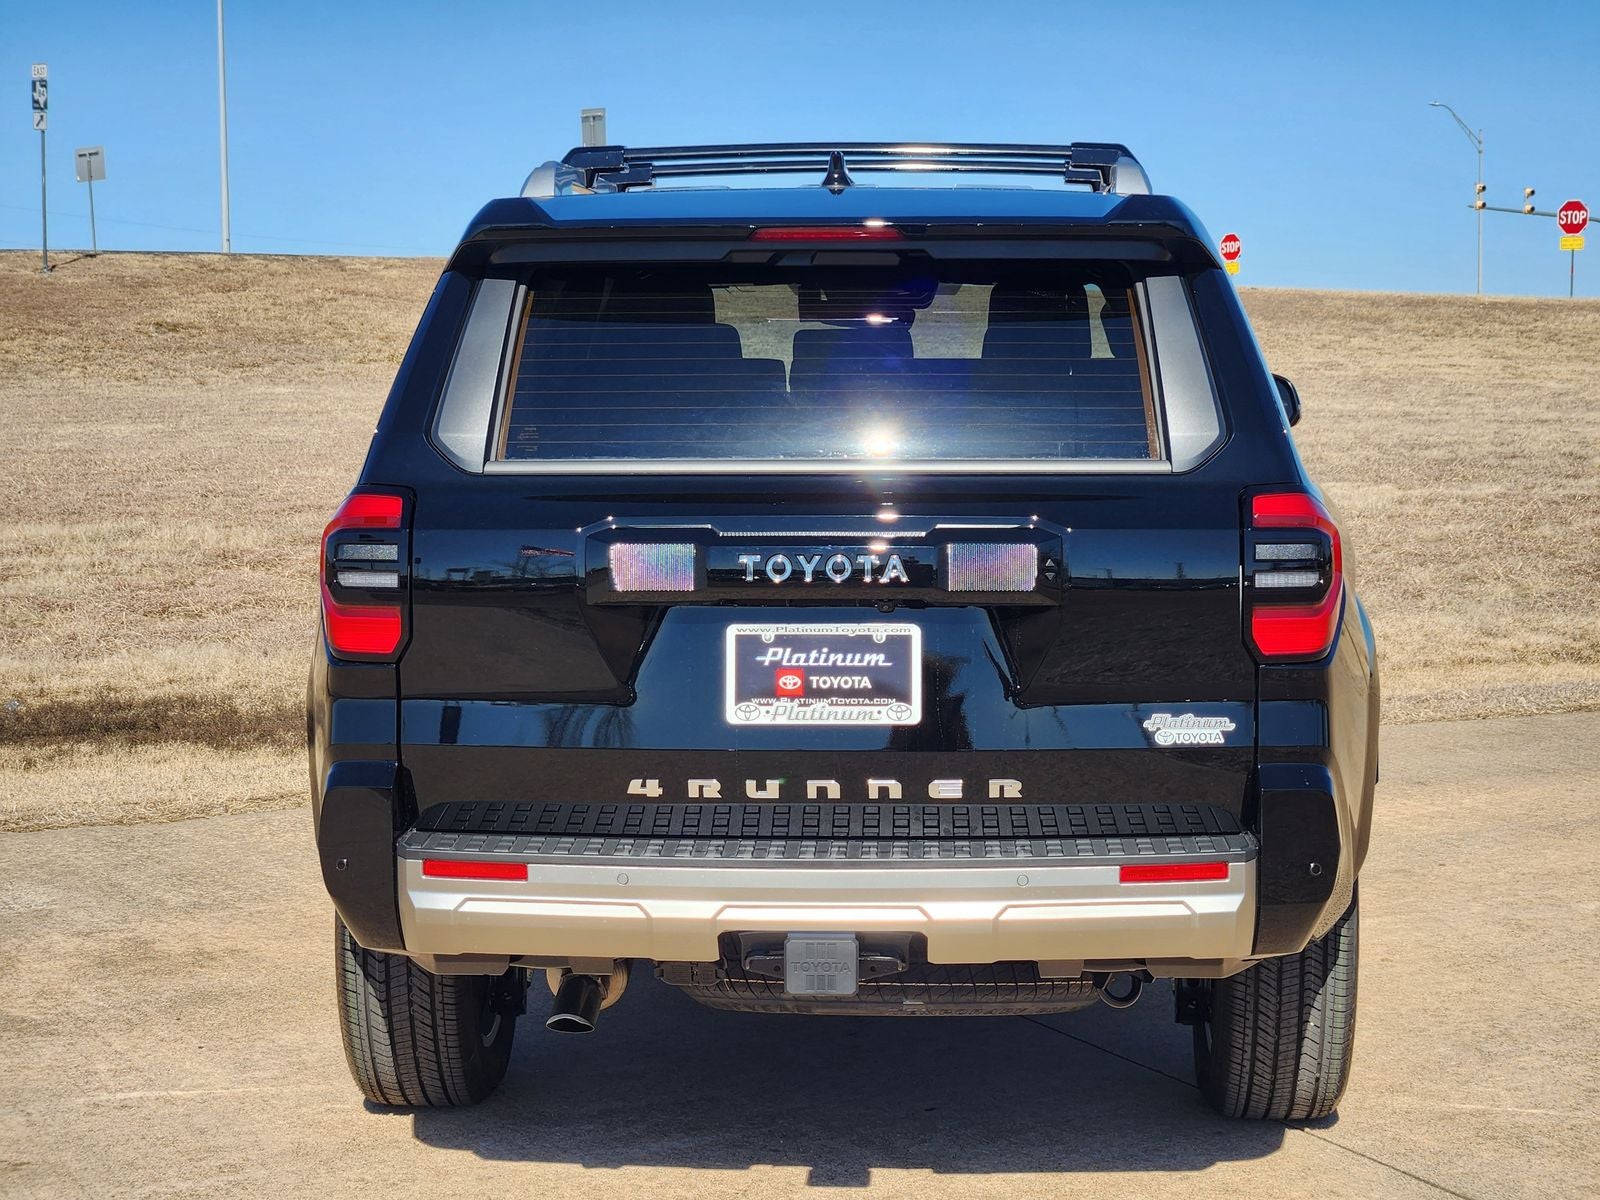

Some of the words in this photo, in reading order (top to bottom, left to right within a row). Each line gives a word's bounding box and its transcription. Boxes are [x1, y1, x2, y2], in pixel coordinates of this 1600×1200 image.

[1559, 210, 1587, 225] STOP
[1221, 241, 1240, 254] STOP
[738, 554, 910, 583] TOYOTA
[736, 626, 911, 636] www.PlatinumToyota.com
[755, 648, 892, 666] Platinum
[809, 676, 872, 689] TOYOTA
[770, 704, 881, 721] Platinum
[1144, 715, 1234, 730] Platinum
[1174, 732, 1223, 742] TOYOTA
[791, 962, 851, 973] TOYOTA
